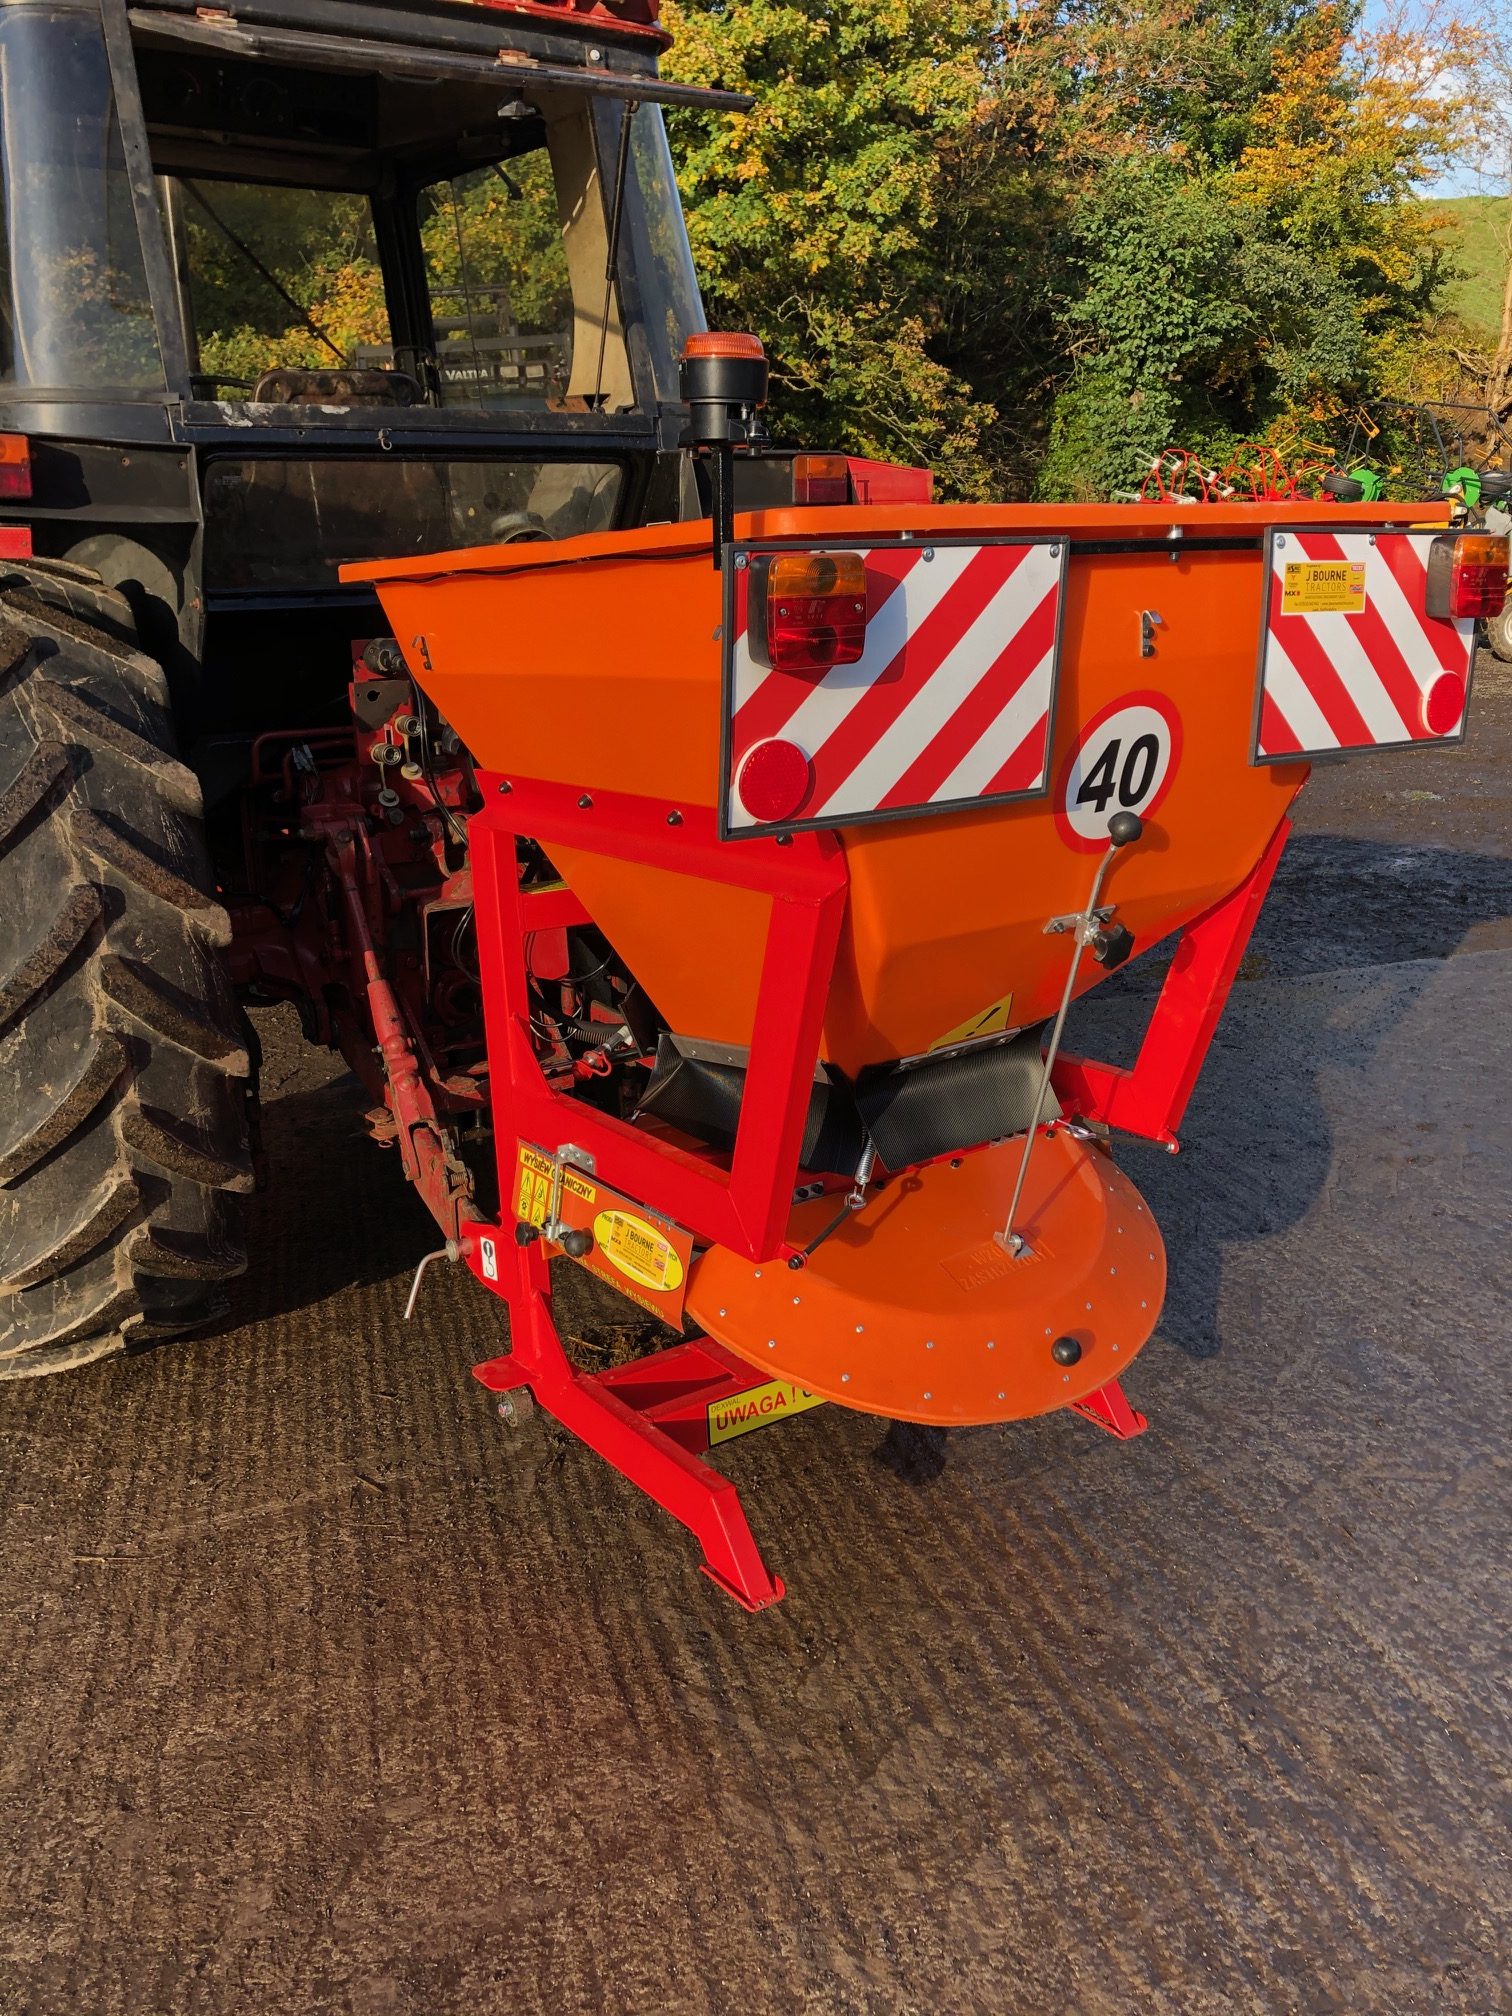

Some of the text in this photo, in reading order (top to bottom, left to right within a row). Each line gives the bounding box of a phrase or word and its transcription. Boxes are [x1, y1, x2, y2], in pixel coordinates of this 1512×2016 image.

[1305, 570, 1347, 581] J BOURNE
[1305, 582, 1347, 592] TRACTORS
[1076, 733, 1159, 813] 40
[630, 1231, 655, 1253] BOURNE
[711, 1398, 741, 1414] DEXWAL
[716, 1391, 787, 1431] UWAGA
